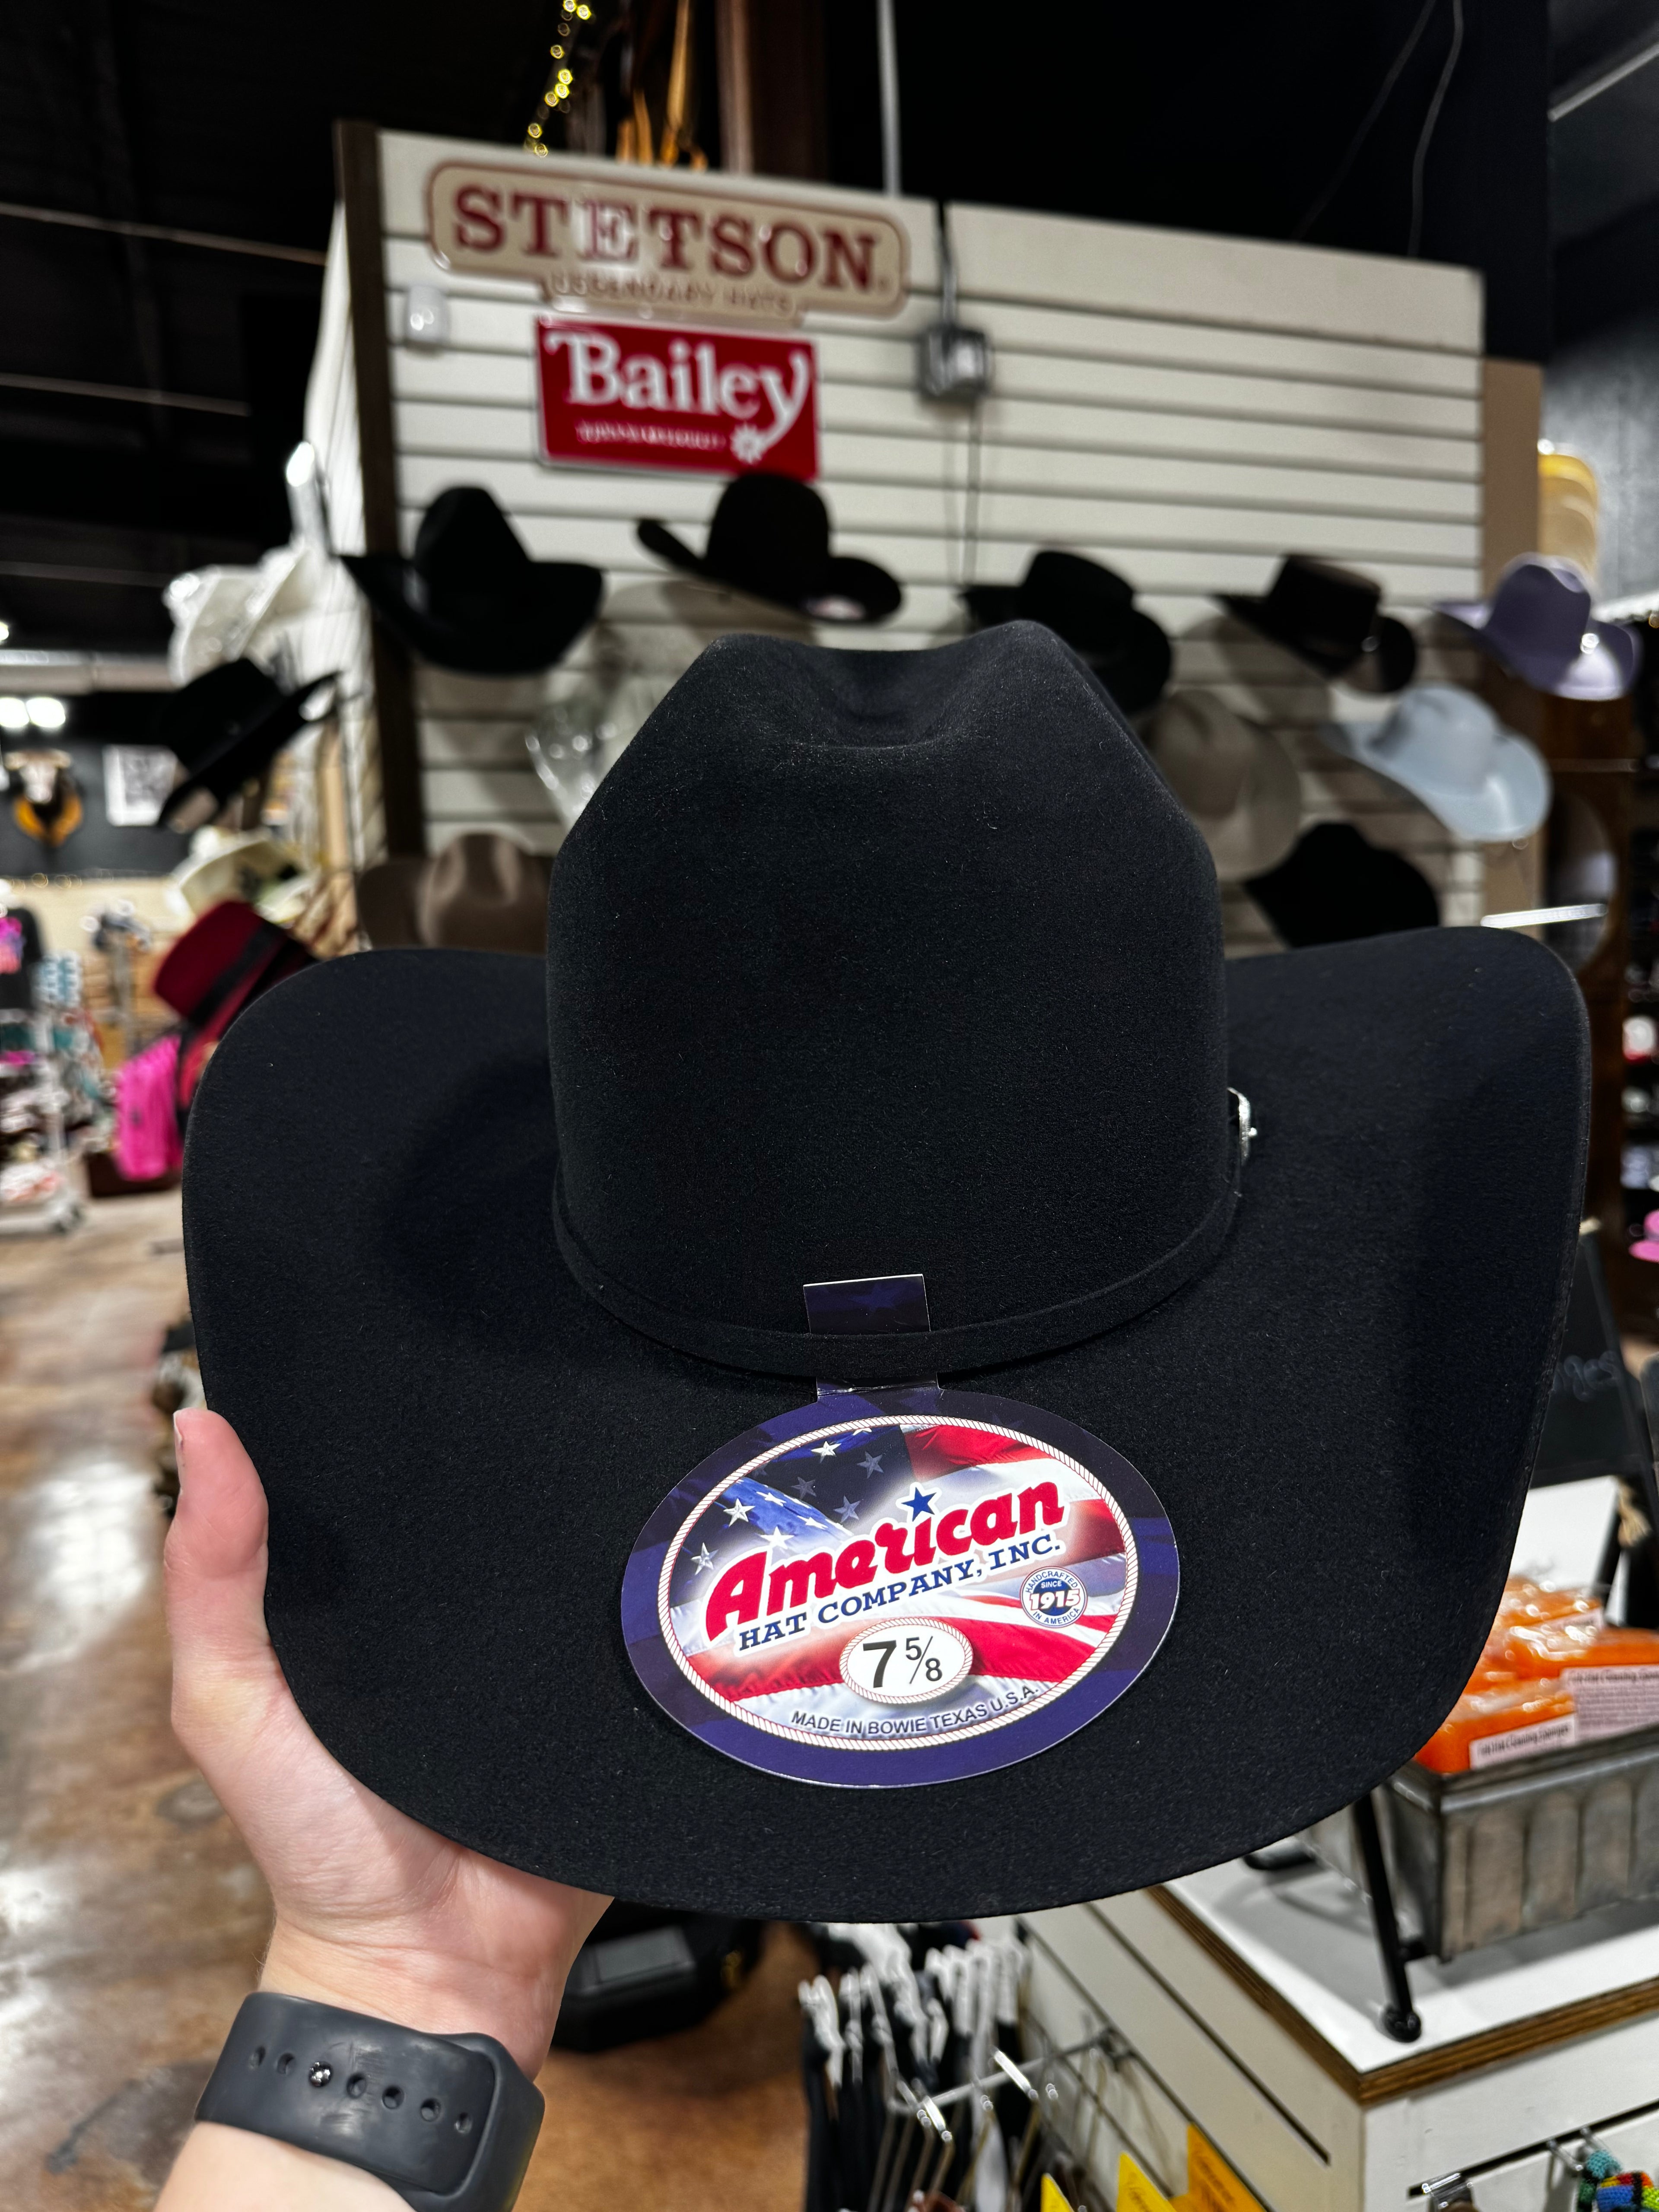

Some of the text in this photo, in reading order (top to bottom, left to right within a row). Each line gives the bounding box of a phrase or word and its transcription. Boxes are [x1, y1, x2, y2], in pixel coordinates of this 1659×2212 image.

[454, 184, 879, 292] STETSON
[542, 329, 810, 451] Bailey
[706, 1482, 1064, 1641] American
[1025, 1571, 1078, 1593] HANDCRAFTED
[1041, 1580, 1062, 1589] SINCE
[739, 1534, 1060, 1651] HAT COMPANY, INC.
[1029, 1589, 1081, 1611] 1915
[1033, 1608, 1080, 1624] IN AMERICA
[862, 1640, 897, 1688] 7
[791, 1685, 1039, 1735] MADE IN BOWIE TEXAS U.S.A.
